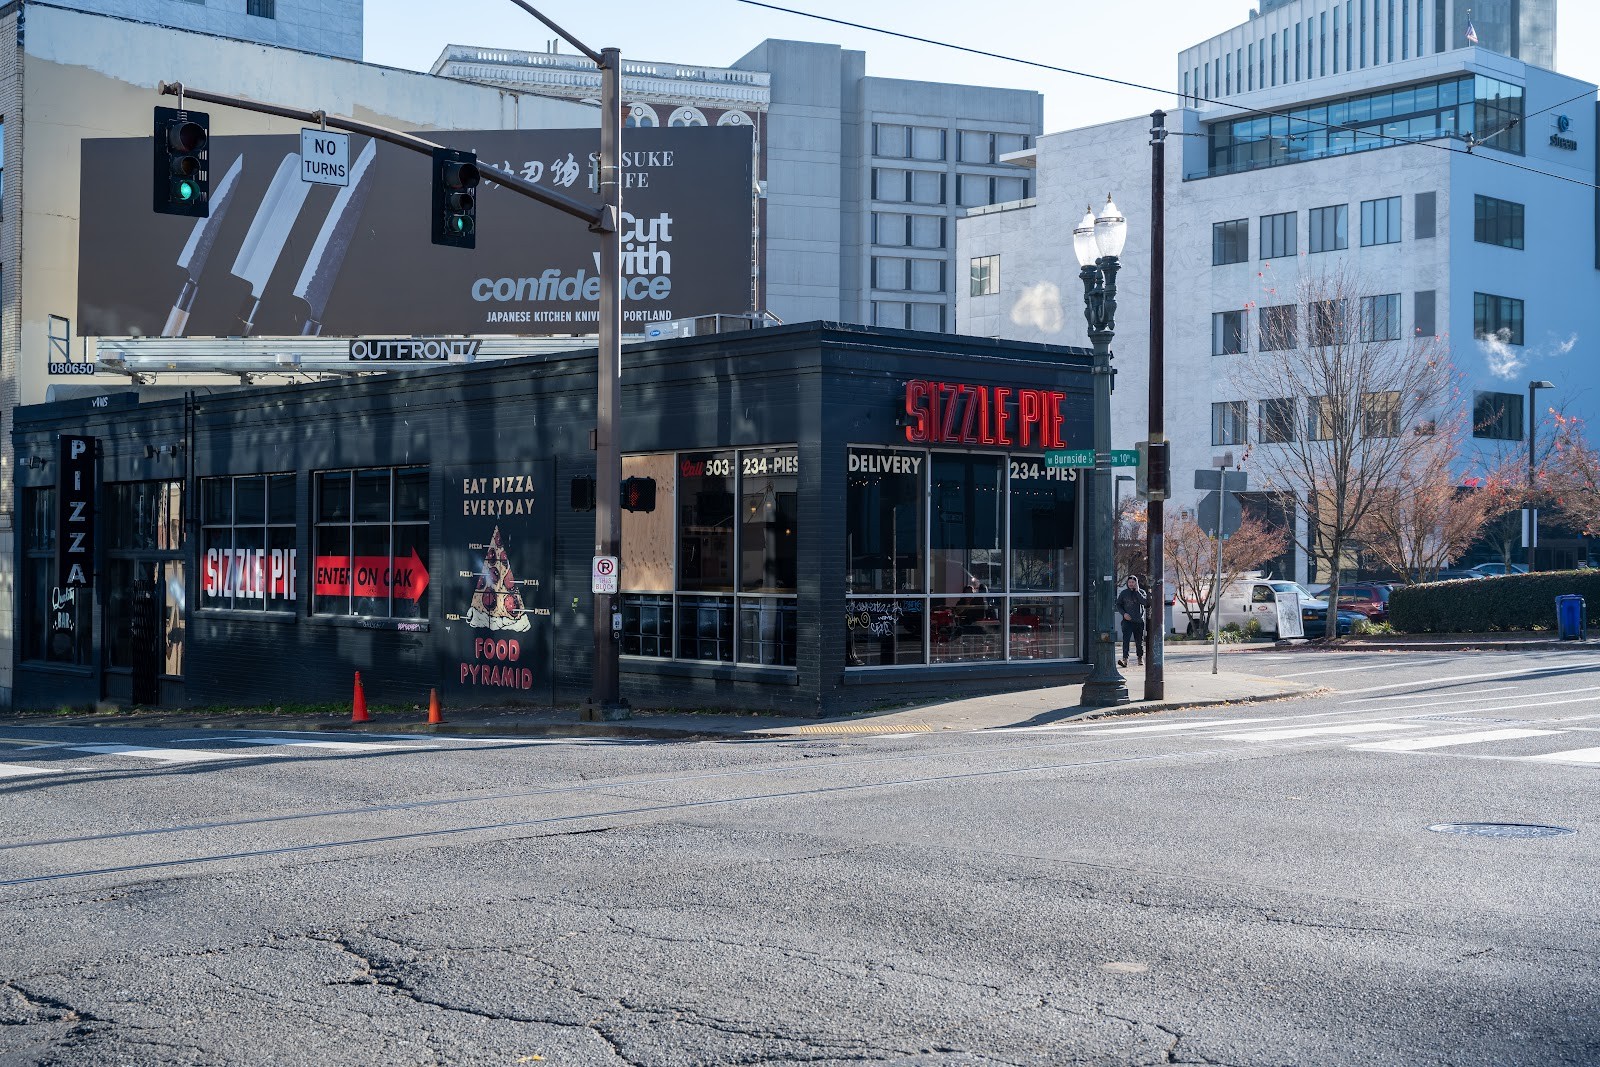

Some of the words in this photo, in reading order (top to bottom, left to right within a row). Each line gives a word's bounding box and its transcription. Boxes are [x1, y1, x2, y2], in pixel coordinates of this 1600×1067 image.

[315, 139, 336, 155] NO
[304, 160, 345, 177] TURNS
[620, 211, 672, 242] Cut
[486, 311, 531, 323] JAPANESE
[534, 311, 572, 322] KITCHEN
[624, 310, 672, 322] PORTLAND
[50, 363, 94, 374] 080650
[906, 379, 1012, 445] SIZZLE
[1018, 388, 1067, 448] PIE
[681, 460, 704, 477] Call
[848, 454, 922, 474] DELIVERY
[1054, 453, 1087, 465] Burnside
[463, 478, 488, 494] EAT
[493, 475, 534, 493] PIZZA
[67, 439, 87, 584] PIZZA
[463, 499, 535, 515] EVERYDAY
[207, 548, 265, 599] SIZZLE
[271, 548, 296, 600] PIE
[317, 567, 350, 585] ENTER
[357, 567, 379, 585] ON
[383, 567, 413, 587] OAK
[475, 637, 520, 661] FOOD
[460, 662, 533, 689] PYRAMID
